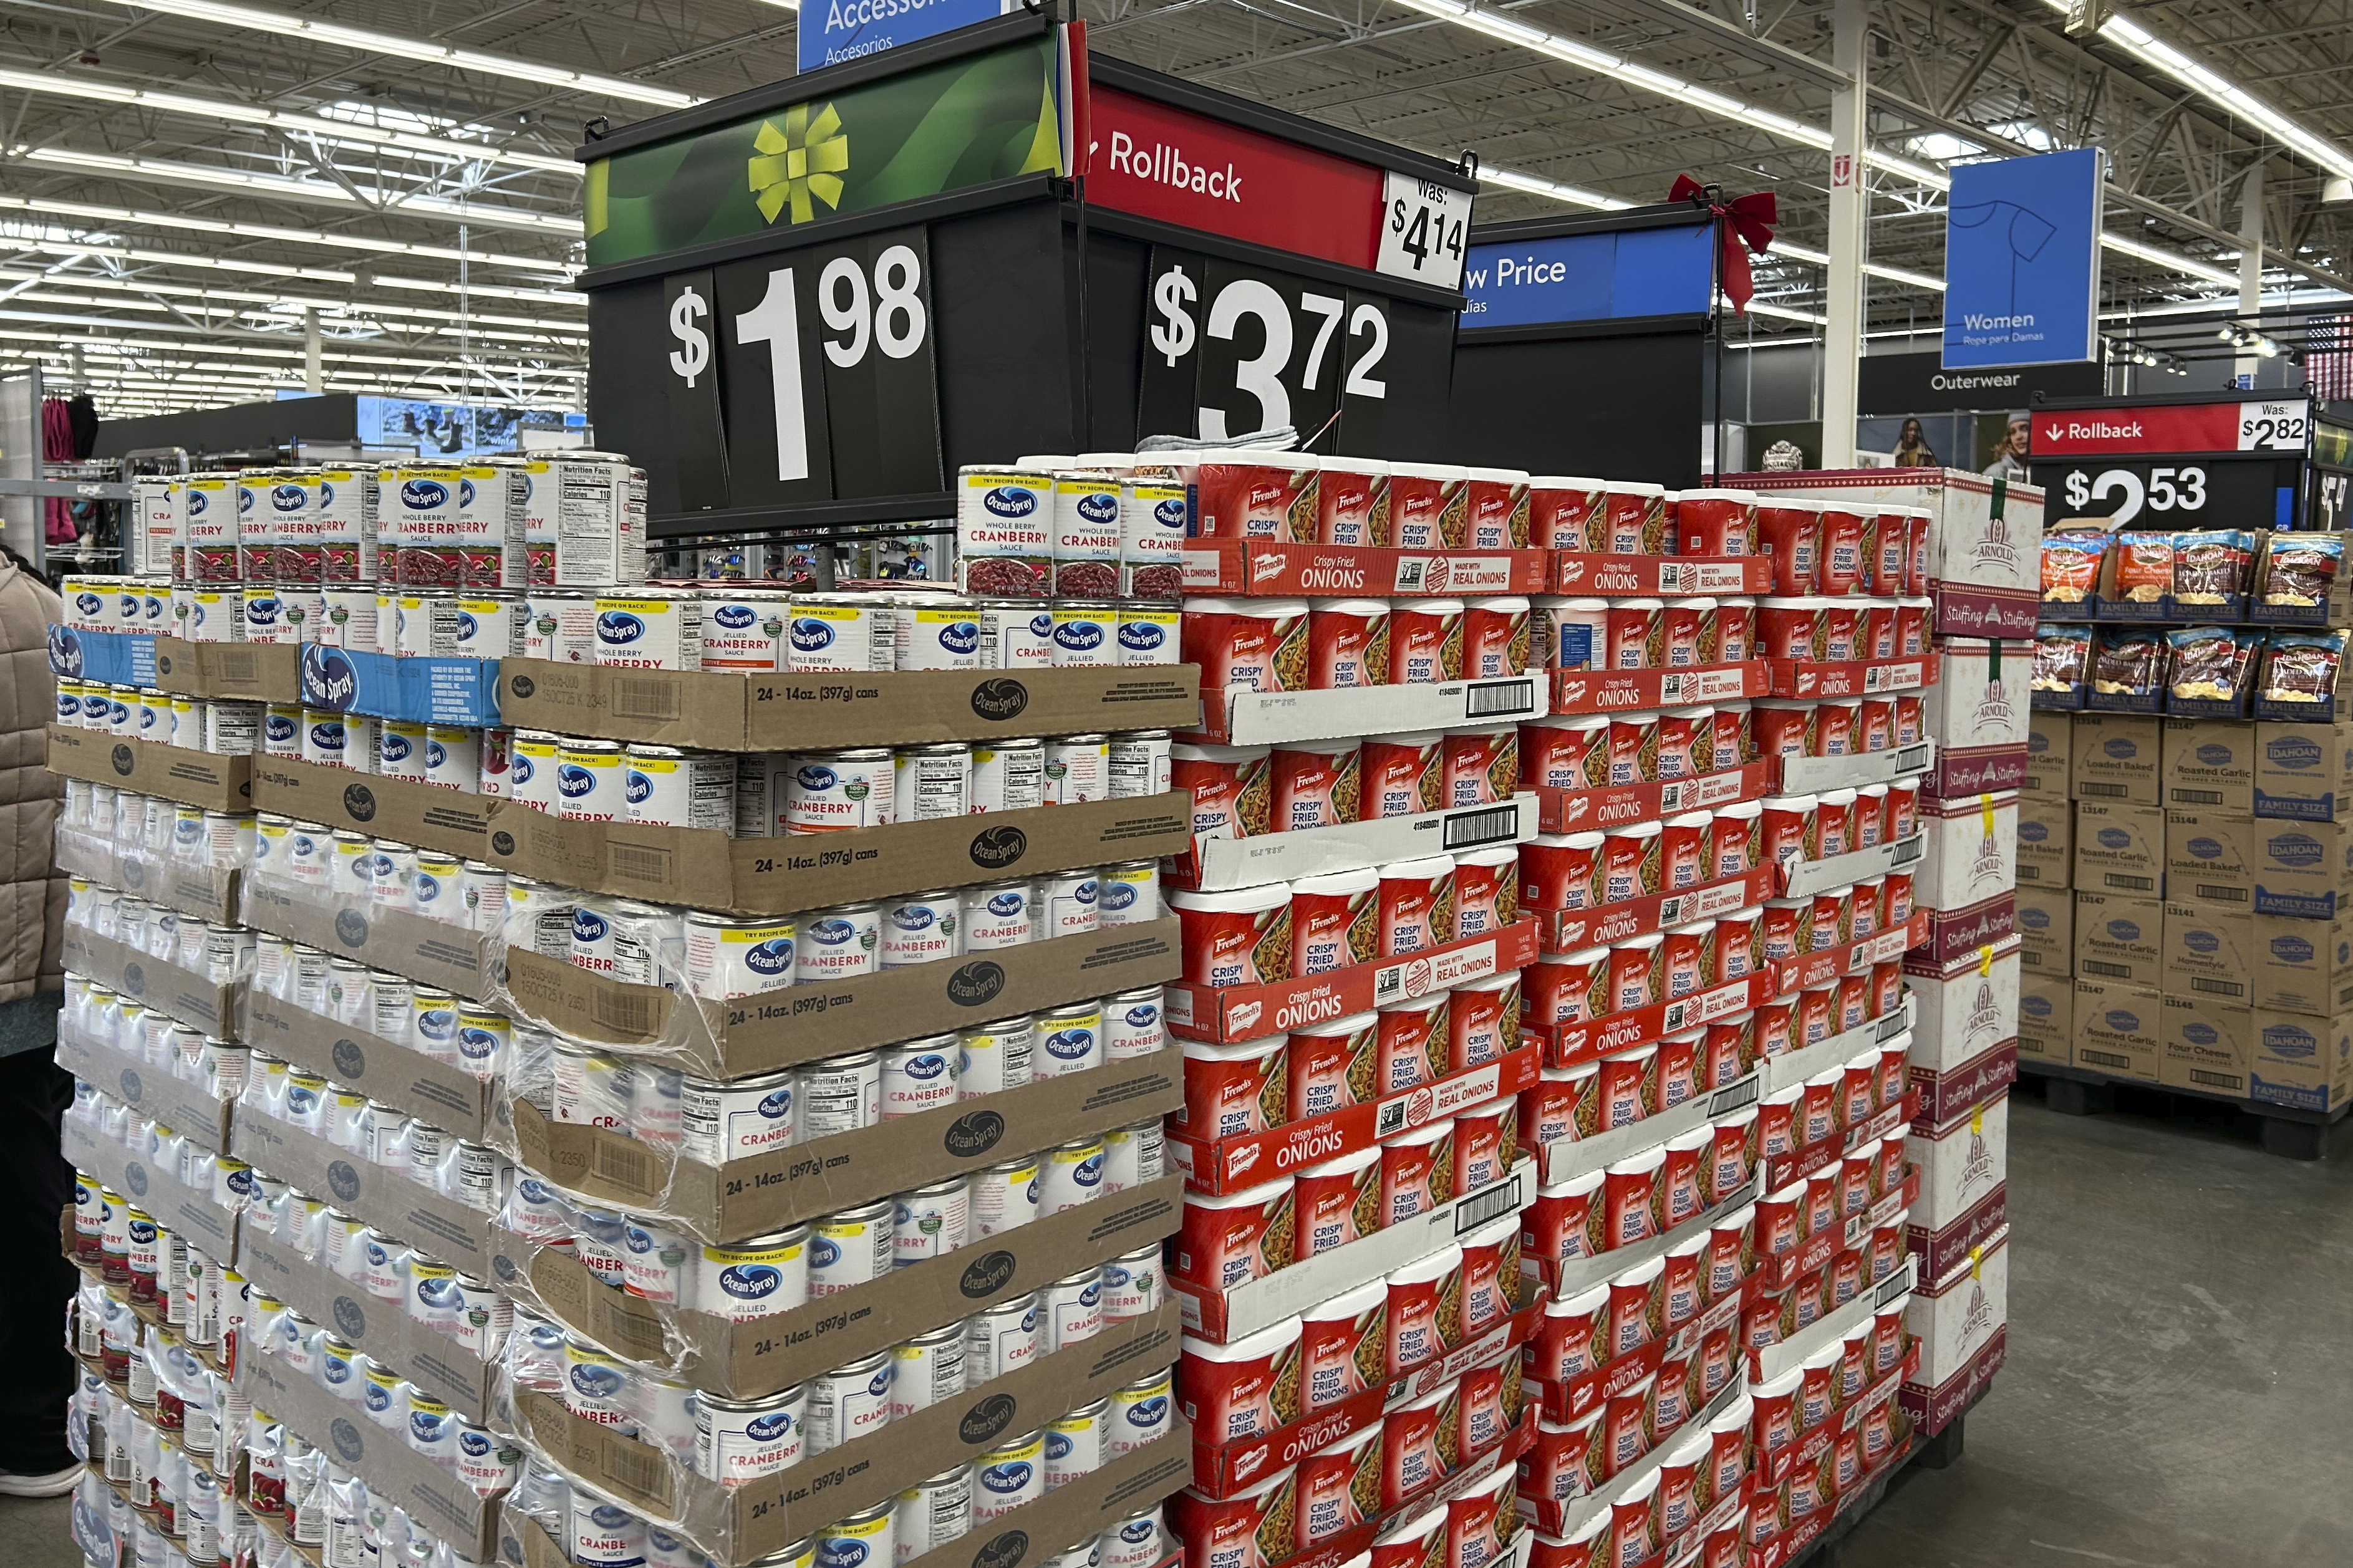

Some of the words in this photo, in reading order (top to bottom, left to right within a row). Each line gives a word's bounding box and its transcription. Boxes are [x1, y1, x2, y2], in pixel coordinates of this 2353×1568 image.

[824, 35, 892, 65] Accesorios
[1110, 131, 1242, 203] Rollback
[1418, 179, 1447, 205] Was:
[1497, 256, 1566, 287] Price
[1964, 314, 2034, 330] Women
[1989, 334, 2009, 346] para
[2012, 332, 2044, 342] Damas
[1931, 374, 2021, 390] Outerwear
[2262, 405, 2289, 416] Was:
[2069, 421, 2142, 439] Rollback
[601, 491, 611, 499] 110
[1252, 489, 1282, 506] French's
[987, 496, 1011, 511] Ocean
[1012, 497, 1032, 514] Spray
[1247, 519, 1278, 532] CRISPY
[1403, 525, 1431, 536] CRISPY
[971, 531, 1047, 544] CRANBERRY
[1403, 534, 1426, 546] FRIED
[1978, 545, 2013, 561] ARNOLD
[2186, 550, 2225, 563] IDAHOAN
[1255, 556, 1285, 574] French's
[1313, 555, 1335, 570] Crispy
[1336, 556, 1355, 567] Fried
[1301, 569, 1365, 589] ONIONS
[1453, 572, 1474, 585] REAL
[1476, 571, 1506, 585] ONIONS
[1595, 572, 1638, 590] ONIONS
[2100, 604, 2135, 612] FAMILY
[2138, 604, 2162, 613] SIZE
[2254, 607, 2293, 616] FAMILY
[2296, 608, 2324, 617] SIZE
[717, 613, 734, 625] Ocean
[734, 612, 754, 627] Spray
[1946, 604, 1984, 628] Stuffing
[2003, 610, 2037, 632] Stuffing
[598, 621, 615, 638] Ocean
[615, 622, 637, 638] Spray
[703, 639, 770, 648] CRANBERRY
[1056, 630, 1080, 645] Ocean
[1080, 631, 1099, 647] Spray
[1234, 636, 1265, 651] French's
[1231, 666, 1263, 678] CRISPY
[305, 660, 326, 699] Ocean
[327, 671, 354, 703] Spray
[1821, 680, 1850, 695] ONIONS
[757, 687, 772, 701] 24
[786, 687, 816, 700] 14oz.
[820, 685, 853, 703] (397g)
[856, 689, 879, 698] cans
[975, 692, 998, 712] Ocean
[999, 691, 1020, 714] Spray
[1597, 689, 1640, 706] ONIONS
[1979, 705, 2008, 718] ARNOLD
[2269, 747, 2319, 758] IDAHOAN
[1296, 771, 1325, 788] French's
[1949, 767, 1981, 789] Stuffing
[2178, 765, 2218, 777] Roasted
[2220, 767, 2251, 779] Garlic
[789, 801, 853, 814] CRANBERRY
[1292, 802, 1323, 814] CRISPY
[2259, 800, 2300, 810] FAMILY
[2302, 804, 2328, 813] SIZE
[974, 842, 997, 860] Ocean
[997, 838, 1020, 861] Spray
[2271, 843, 2321, 855] IDAHOAN
[755, 859, 773, 873] 24
[787, 856, 816, 870] 14oz.
[819, 848, 852, 867] (397g)
[856, 849, 878, 861] cans
[1974, 862, 2000, 875] ARNOLD
[2170, 859, 2208, 870] Loaded
[2210, 861, 2241, 873] Baked
[973, 923, 1030, 938] CRANBERRY
[1593, 917, 1638, 942] ONIONS
[1946, 925, 1976, 949] Stuffing
[1987, 911, 2014, 934] Stuffing
[1308, 943, 1338, 955] CRISPY
[1437, 966, 1458, 983] REAL
[1460, 956, 1492, 978] ONIONS
[2177, 956, 2226, 970] Homestyle
[951, 978, 975, 997] Ocean
[975, 973, 997, 997] Spray
[1288, 989, 1311, 1006] Crispy
[1312, 984, 1330, 999] Fried
[729, 1010, 745, 1026] 24
[758, 1006, 789, 1021] 14oz.
[793, 995, 827, 1016] (397g)
[830, 994, 853, 1006] cans
[1276, 994, 1342, 1030] ONIONS
[1968, 1009, 1996, 1031] ARNOLD
[1048, 1040, 1071, 1054] Ocean
[1072, 1037, 1090, 1054] Spray
[1112, 1032, 1162, 1047] CRANBERRY
[2168, 1042, 2191, 1053] Four
[2193, 1047, 2232, 1059] Cheese
[1945, 1079, 1974, 1110] Stuffing
[1987, 1061, 2017, 1085] Stuffing
[1438, 1094, 1460, 1110] REAL
[1462, 1080, 1494, 1104] ONIONS
[2254, 1085, 2296, 1101] FAMILY
[2297, 1091, 2324, 1105] SIZE
[950, 1129, 974, 1148] Ocean
[974, 1122, 997, 1148] Spray
[1277, 1130, 1343, 1168] ONIONS
[1963, 1158, 1989, 1183] ARNOLD
[1938, 1234, 1967, 1267] Stuffing
[723, 1274, 748, 1292] Ocean
[748, 1274, 775, 1294] Spray
[1963, 1307, 1988, 1338] ARNOLD
[1313, 1366, 1345, 1382] CRISPY
[1312, 1384, 1348, 1403] ONIONS
[1283, 1415, 1351, 1461] ONIONS
[729, 1441, 801, 1466] CRANBERRY
[752, 1502, 768, 1519] 24
[780, 1488, 809, 1508] 14oz.
[812, 1467, 844, 1494] (397g)
[847, 1460, 870, 1477] cans
